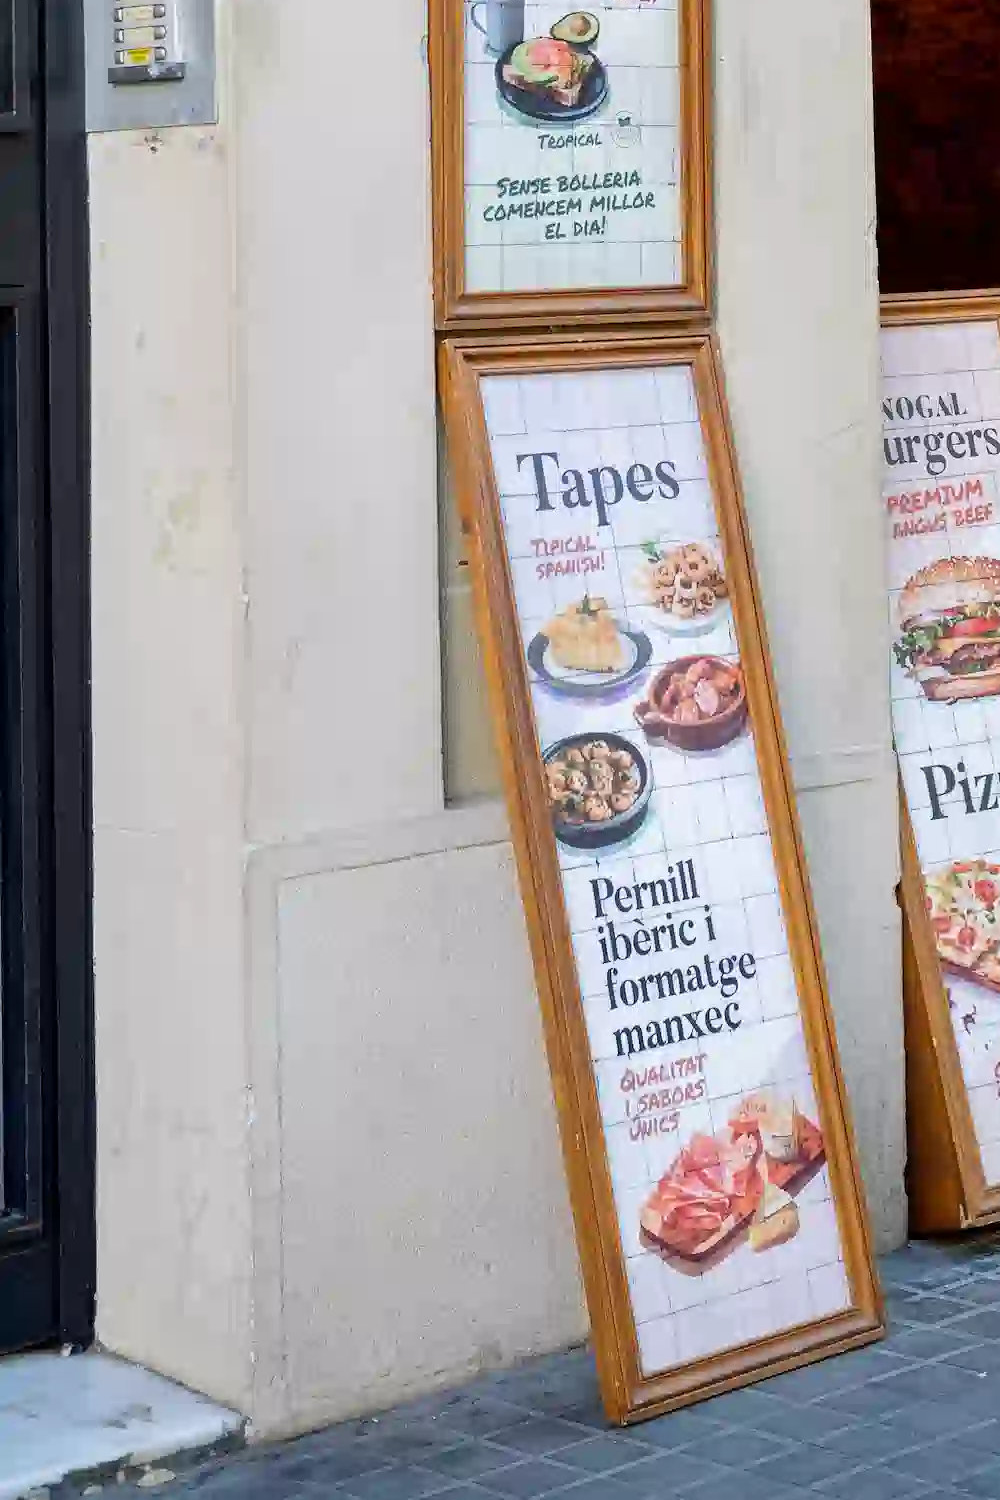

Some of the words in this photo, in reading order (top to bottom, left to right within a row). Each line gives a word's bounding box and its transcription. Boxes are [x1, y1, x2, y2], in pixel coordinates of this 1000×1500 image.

[537, 132, 602, 151] TROPICAL
[497, 176, 552, 198] SENSE
[556, 169, 641, 193] BOLLERIA
[483, 198, 582, 222] COMENCEM
[590, 192, 656, 213] MILLOR
[545, 222, 567, 240] EL
[574, 215, 607, 237] DIA!
[881, 392, 968, 421] NOGAL
[516, 452, 681, 527] Tapes
[886, 480, 983, 514] PREMIUM
[893, 513, 947, 538] ANGUS
[955, 503, 993, 526] BEEF
[589, 858, 700, 918] Pernill
[598, 912, 697, 964] ibèric
[704, 904, 717, 941] i
[605, 952, 757, 1011] formatge
[620, 1053, 707, 1092] QUALITAT
[635, 1077, 706, 1113] SABORS
